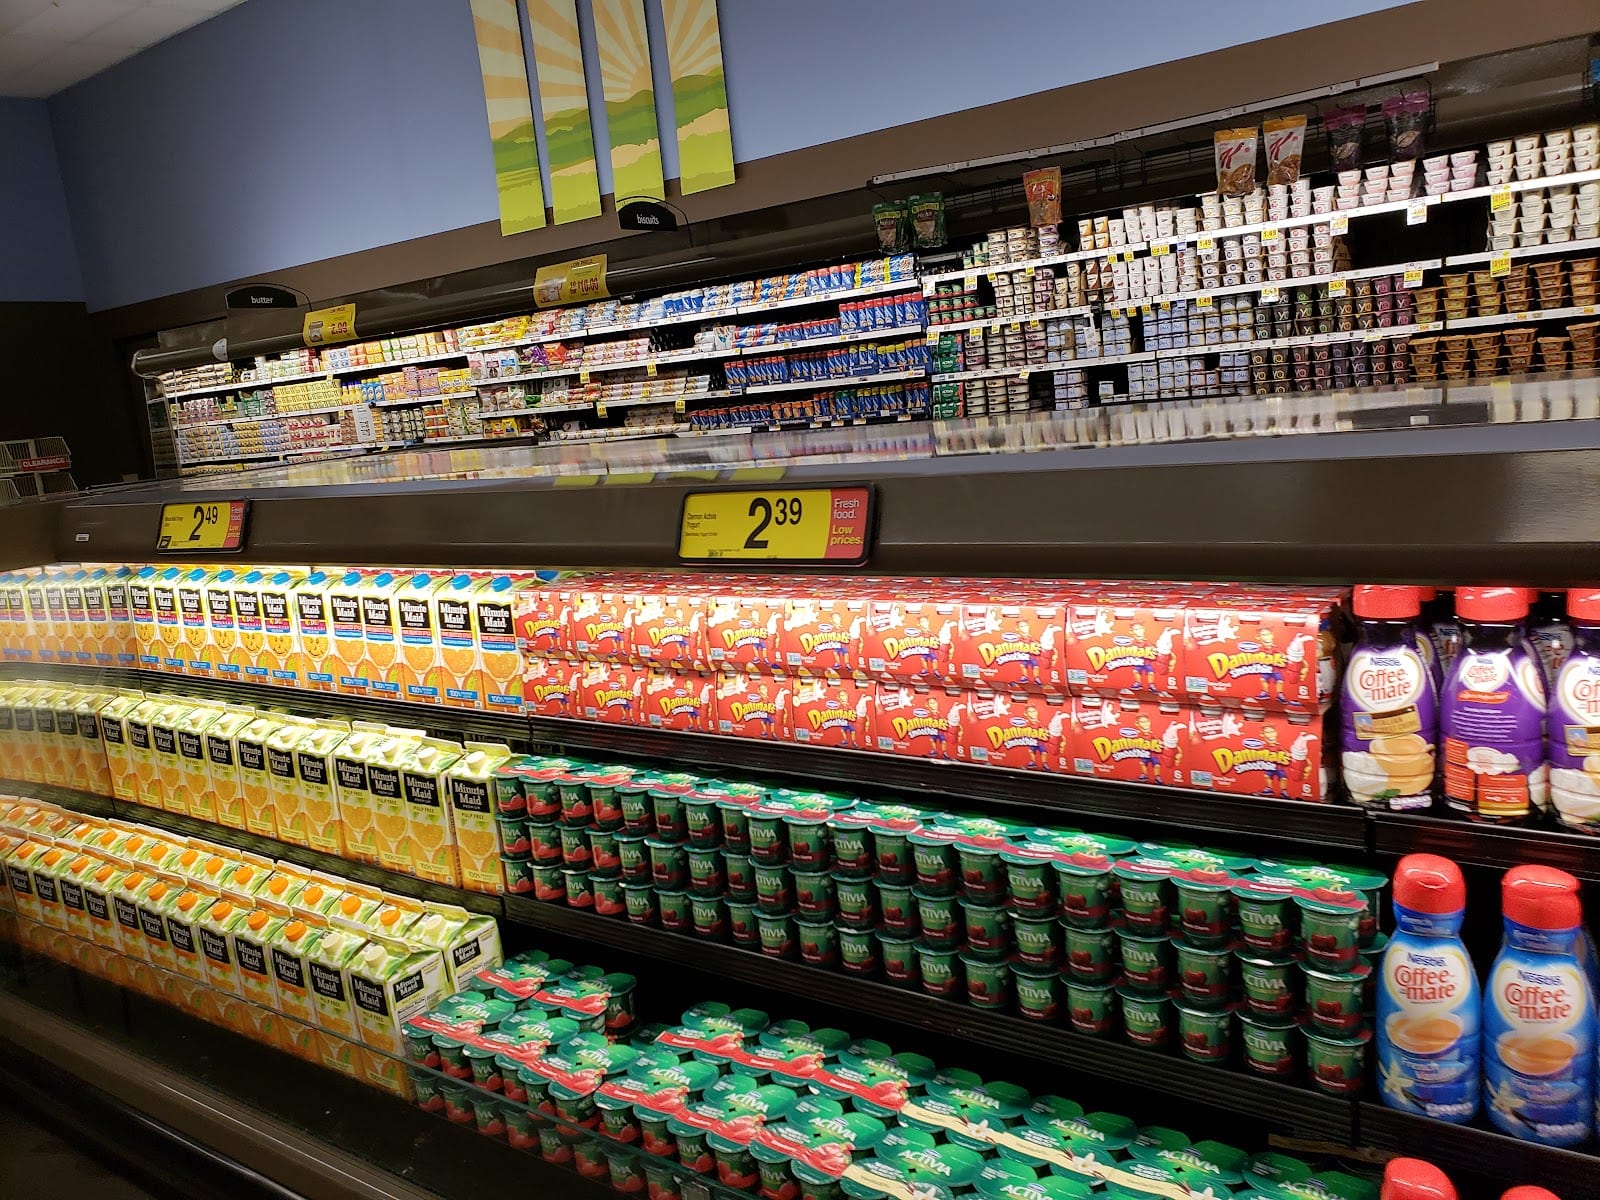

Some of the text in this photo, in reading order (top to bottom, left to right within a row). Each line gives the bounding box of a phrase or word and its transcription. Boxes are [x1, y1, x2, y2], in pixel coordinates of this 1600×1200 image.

[637, 214, 660, 225] biscuits
[250, 295, 274, 304] butter
[23, 457, 66, 467] CLEARANCE
[834, 498, 860, 509] Fresh
[833, 509, 856, 520] food.
[832, 524, 853, 535] Low
[830, 535, 863, 546] prices.
[364, 600, 389, 611] Minute
[400, 601, 427, 613] Minute
[440, 603, 467, 615] Minute
[480, 606, 509, 618] Minute
[405, 612, 424, 623] Maid
[445, 613, 465, 624] Maid
[485, 617, 506, 628] Maid
[800, 632, 850, 655] Danimals
[883, 636, 940, 660] Danimals
[978, 641, 1041, 667] Danimals
[1085, 646, 1158, 672] Danimals
[1207, 652, 1287, 679] Danimals
[1360, 668, 1405, 690] Coffee
[1371, 681, 1411, 701] mate
[808, 709, 857, 731] Danimals
[892, 716, 948, 739] Danimals
[987, 725, 1049, 750] Danimals
[1093, 736, 1163, 762] Danimals
[301, 756, 323, 769] Minute
[338, 761, 364, 775] Minute
[1212, 747, 1292, 775] Danimals
[342, 772, 360, 784] Maid
[370, 769, 397, 783] Minute
[406, 776, 435, 790] Minute
[376, 780, 394, 792] Maid
[412, 788, 432, 799] Maid
[454, 782, 485, 796] Minute
[460, 794, 482, 806] Maid
[238, 942, 261, 958] Minute
[275, 953, 299, 970] Minute
[1407, 952, 1446, 967] Nestlé
[280, 966, 297, 979] Maid
[312, 966, 339, 983] Minute
[1394, 965, 1450, 986] Coffee
[1518, 969, 1563, 986] Nestlé
[318, 978, 337, 993] Maid
[354, 979, 382, 998] Minute
[1406, 983, 1456, 1000] mate
[360, 992, 380, 1007] Maid
[1504, 982, 1564, 1006] Coffee
[1518, 1003, 1572, 1019] mate
[576, 1049, 613, 1068] ACTIVIA
[650, 1067, 691, 1087] ACTIVIA
[725, 1093, 769, 1113] ACTIVIA
[950, 1087, 1000, 1110] ACTIVIA
[809, 1116, 857, 1141] ACTIVIA
[1050, 1118, 1105, 1141] ACTIVIA
[898, 1150, 950, 1176] ACTIVIA
[1157, 1149, 1220, 1174] ACTIVIA
